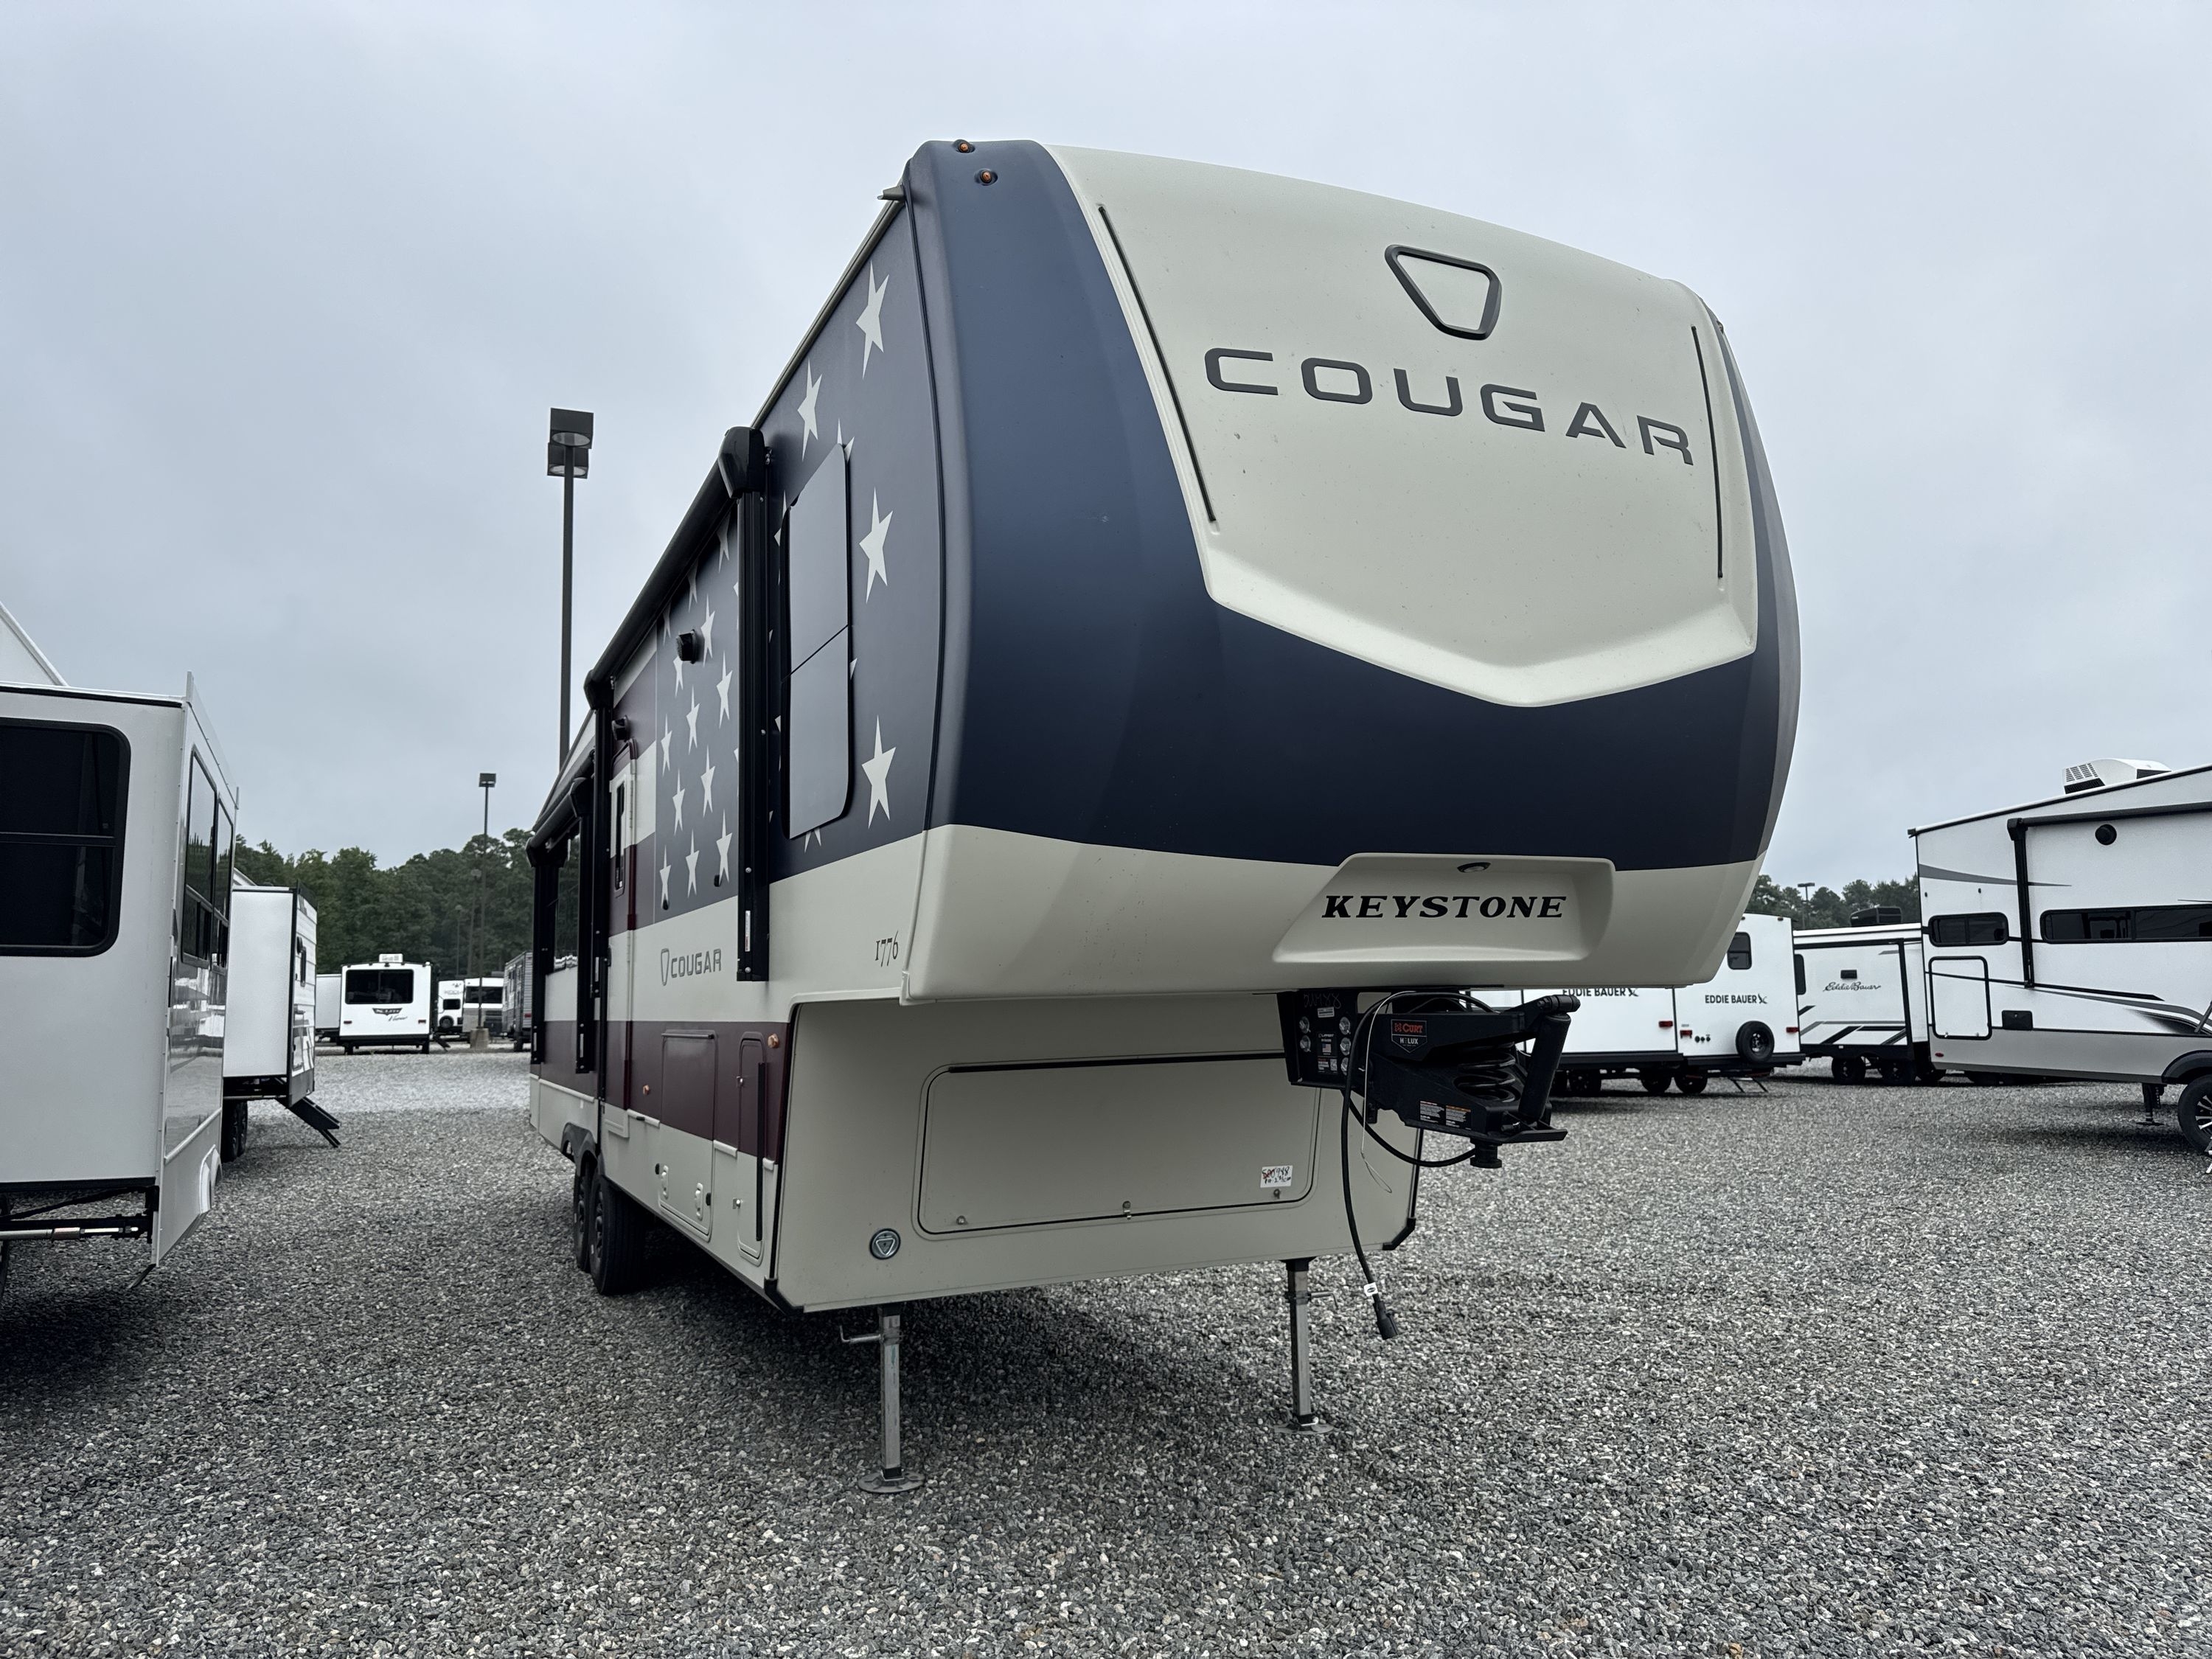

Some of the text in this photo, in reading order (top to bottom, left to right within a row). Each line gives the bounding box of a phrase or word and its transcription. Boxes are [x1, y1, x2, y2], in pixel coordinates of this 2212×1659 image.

[1204, 347, 1694, 466] COUGAR
[1321, 895, 1566, 918] KEYSTONE
[874, 929, 899, 967] 1776
[671, 948, 722, 978] COUGAR
[1562, 988, 1626, 996] EDDIE BAUER
[1823, 981, 1882, 992] Eddie Bauer
[1705, 995, 1757, 1004] EDDIE BAUER
[1402, 1023, 1423, 1033] CURT
